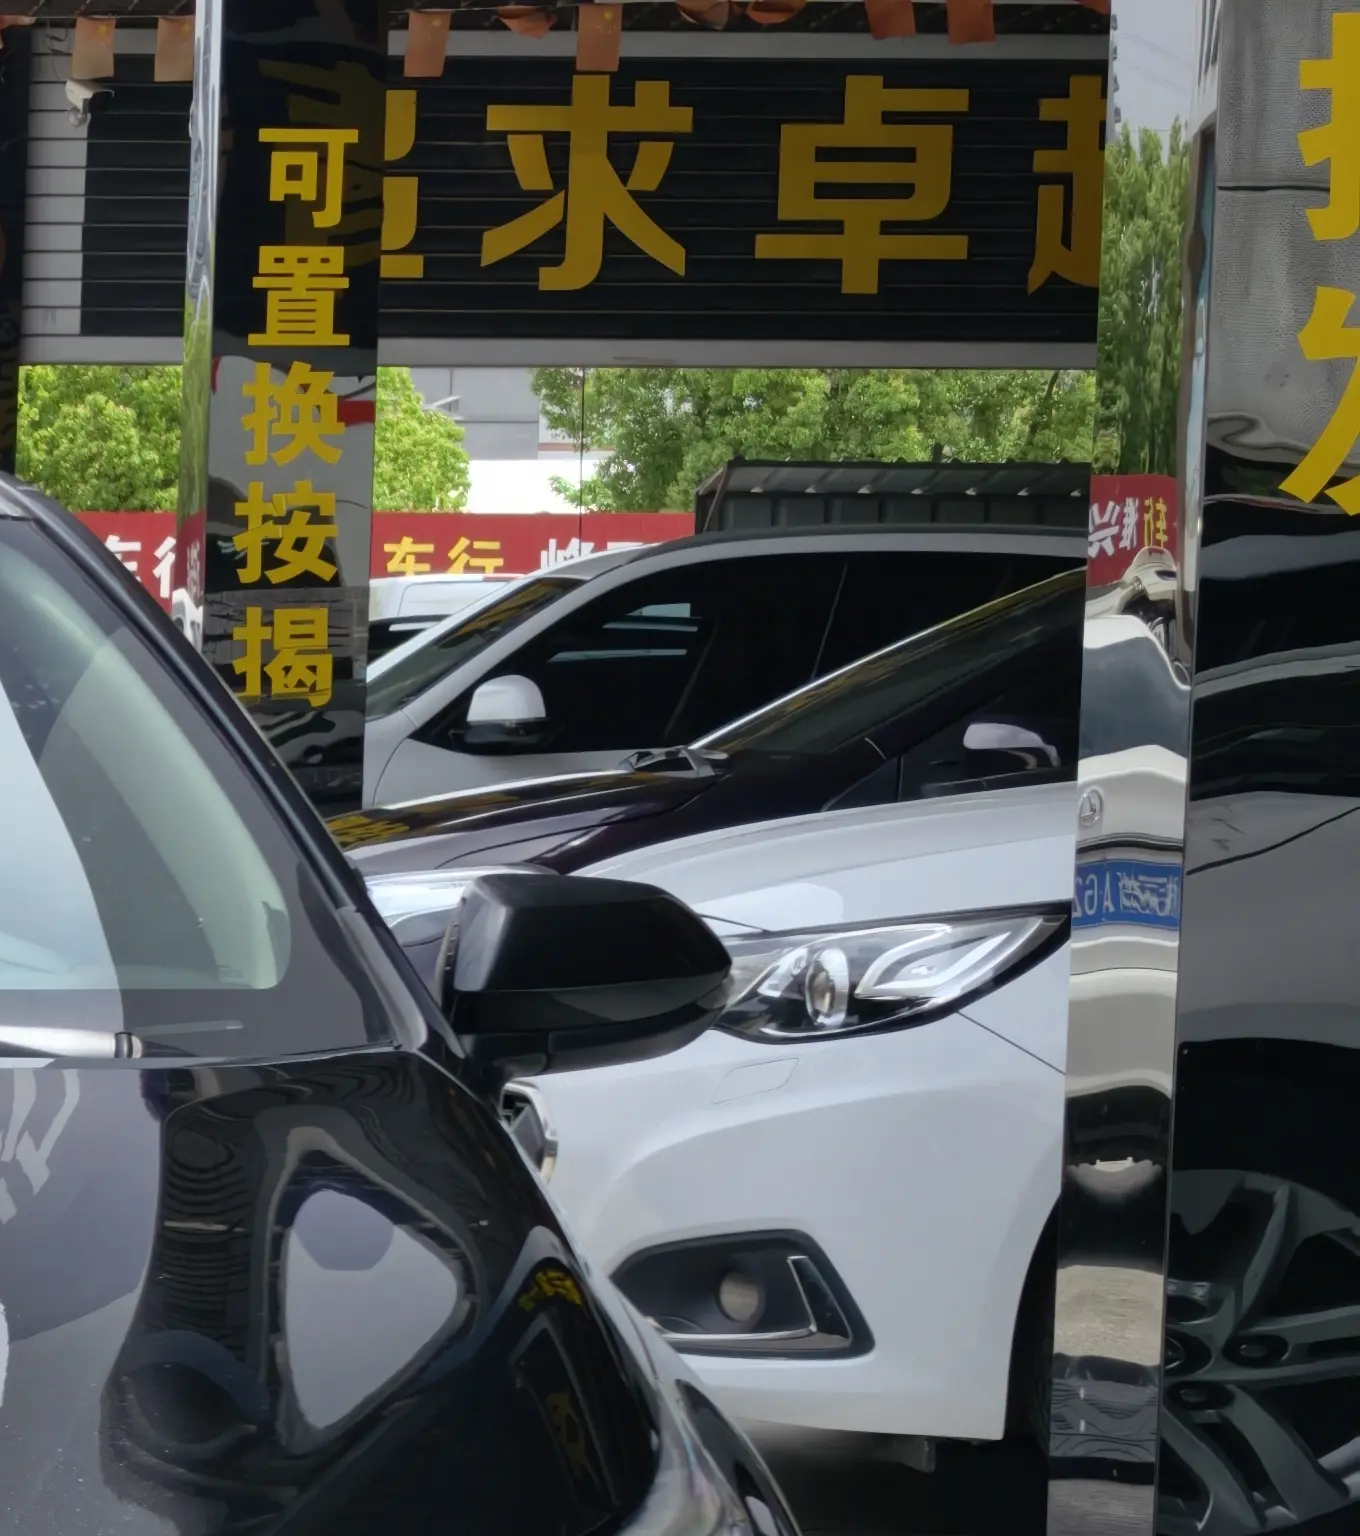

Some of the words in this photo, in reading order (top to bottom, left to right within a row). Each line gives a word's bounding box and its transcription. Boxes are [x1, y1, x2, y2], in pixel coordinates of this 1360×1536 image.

[233, 128, 359, 707] 可置换按揭
